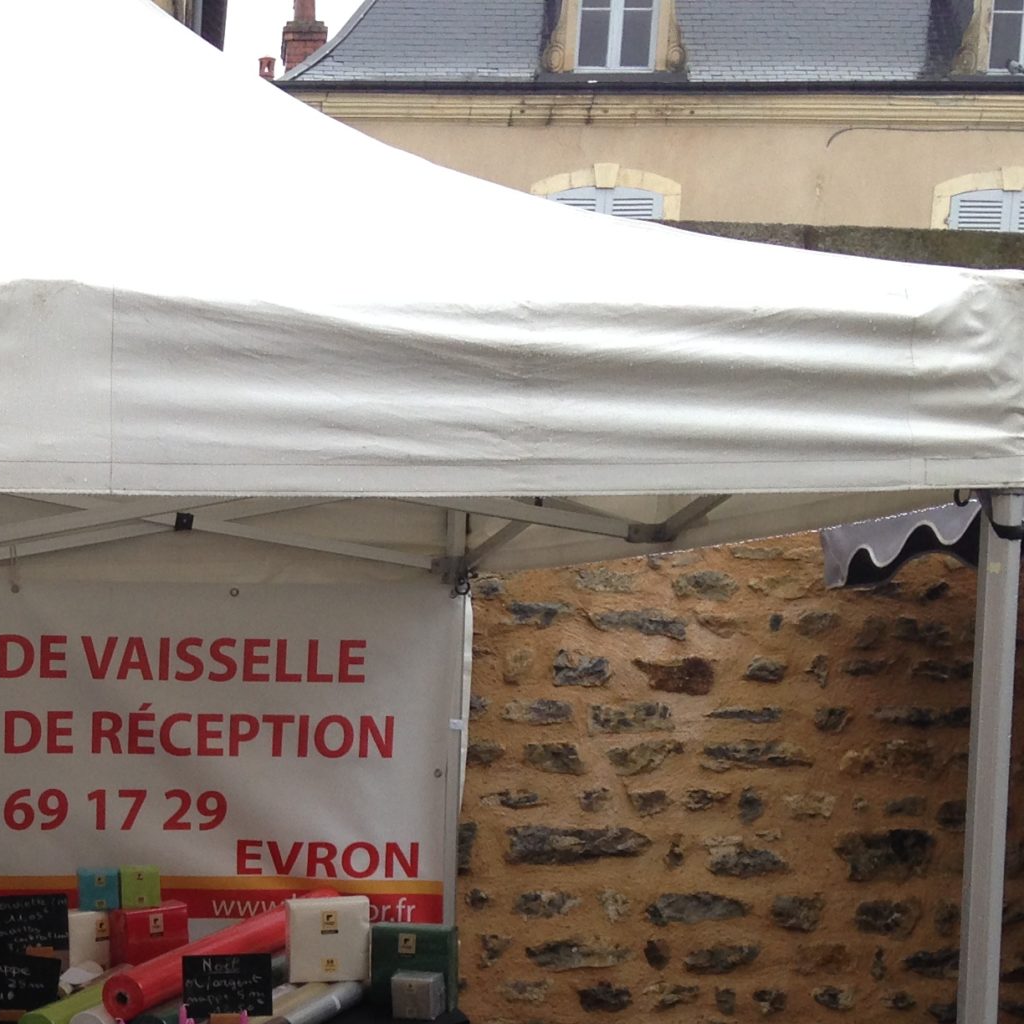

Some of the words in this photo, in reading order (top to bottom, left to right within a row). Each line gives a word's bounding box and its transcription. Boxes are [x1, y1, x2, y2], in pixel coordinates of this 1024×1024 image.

[81, 635, 367, 684] VAISSELLE
[4, 710, 74, 755] DE
[91, 703, 395, 759] RÉCEPTION
[4, 788, 69, 831] 69
[87, 788, 148, 831] 17
[163, 789, 228, 831] 29
[236, 839, 420, 878] EVRON
